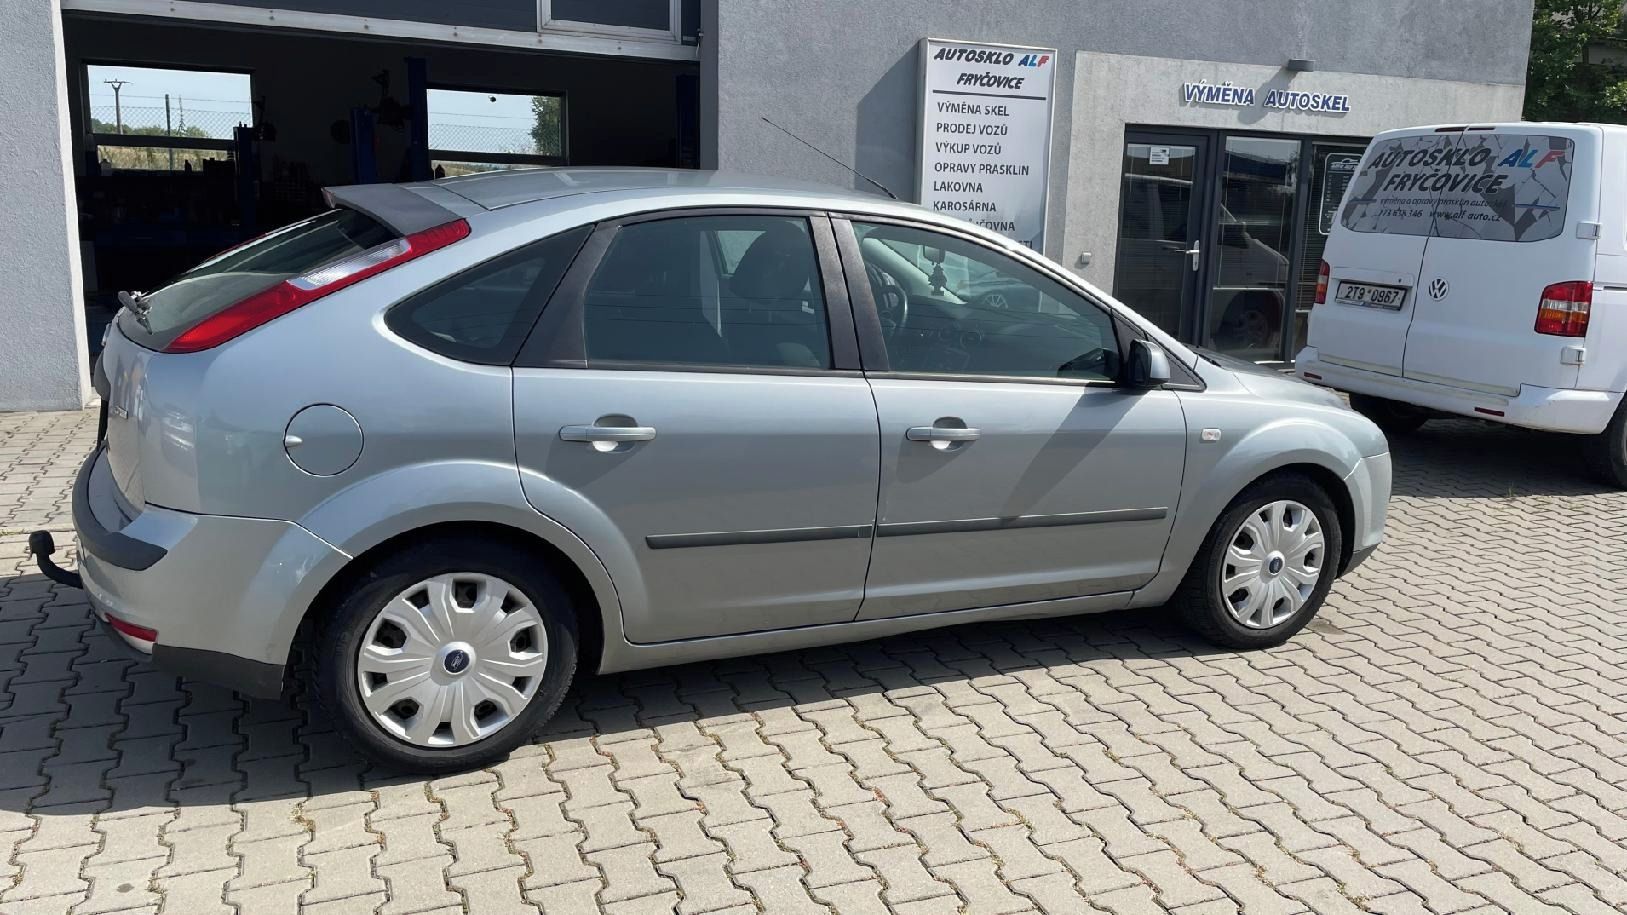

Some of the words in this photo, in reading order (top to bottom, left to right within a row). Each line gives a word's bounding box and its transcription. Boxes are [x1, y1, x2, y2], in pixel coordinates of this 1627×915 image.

[934, 48, 1014, 66] AUTOSKLO
[1018, 54, 1050, 67] ALF
[957, 72, 1024, 89] FRYČOVICE
[1184, 80, 1255, 105] VÝMĚNA
[1264, 89, 1351, 113] AUTOSKEL
[937, 100, 981, 115] VÝMĚNA
[984, 105, 1010, 117] SKEL
[936, 122, 976, 135] PRODEJ
[979, 124, 1008, 136] VOZŮ
[935, 141, 970, 154] VÝKUP
[973, 142, 1002, 155] VOZŮ
[1368, 147, 1492, 170] AUTOSKLO
[1498, 149, 1566, 169] ALF
[934, 162, 976, 174] OPRAVY
[979, 163, 1030, 176] PRASKLIN
[933, 181, 983, 193] LAKOVNA
[1383, 168, 1508, 194] FRYČOVICE
[933, 200, 997, 212] KAROSÁRNA
[1345, 285, 1366, 300] 2T9
